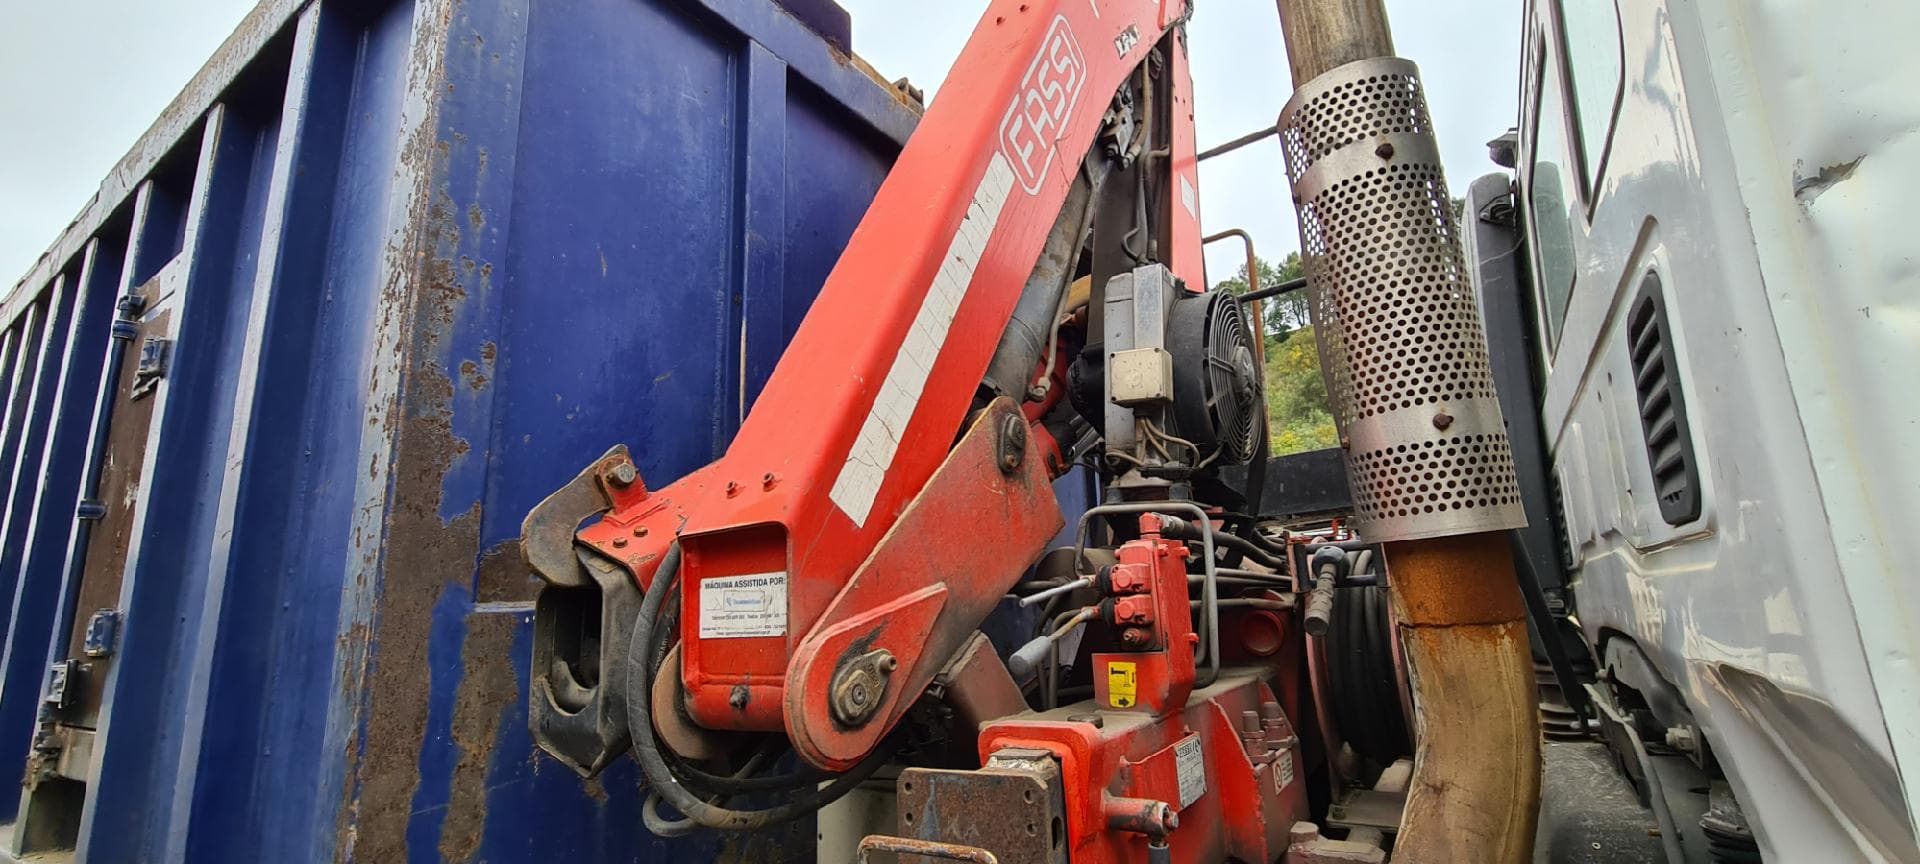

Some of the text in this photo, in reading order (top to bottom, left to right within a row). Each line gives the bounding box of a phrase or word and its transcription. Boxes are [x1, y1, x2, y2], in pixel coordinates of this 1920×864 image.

[1008, 29, 1081, 179] FASSI
[704, 576, 786, 590] MÁQUINA ASSISTIDA POR:
